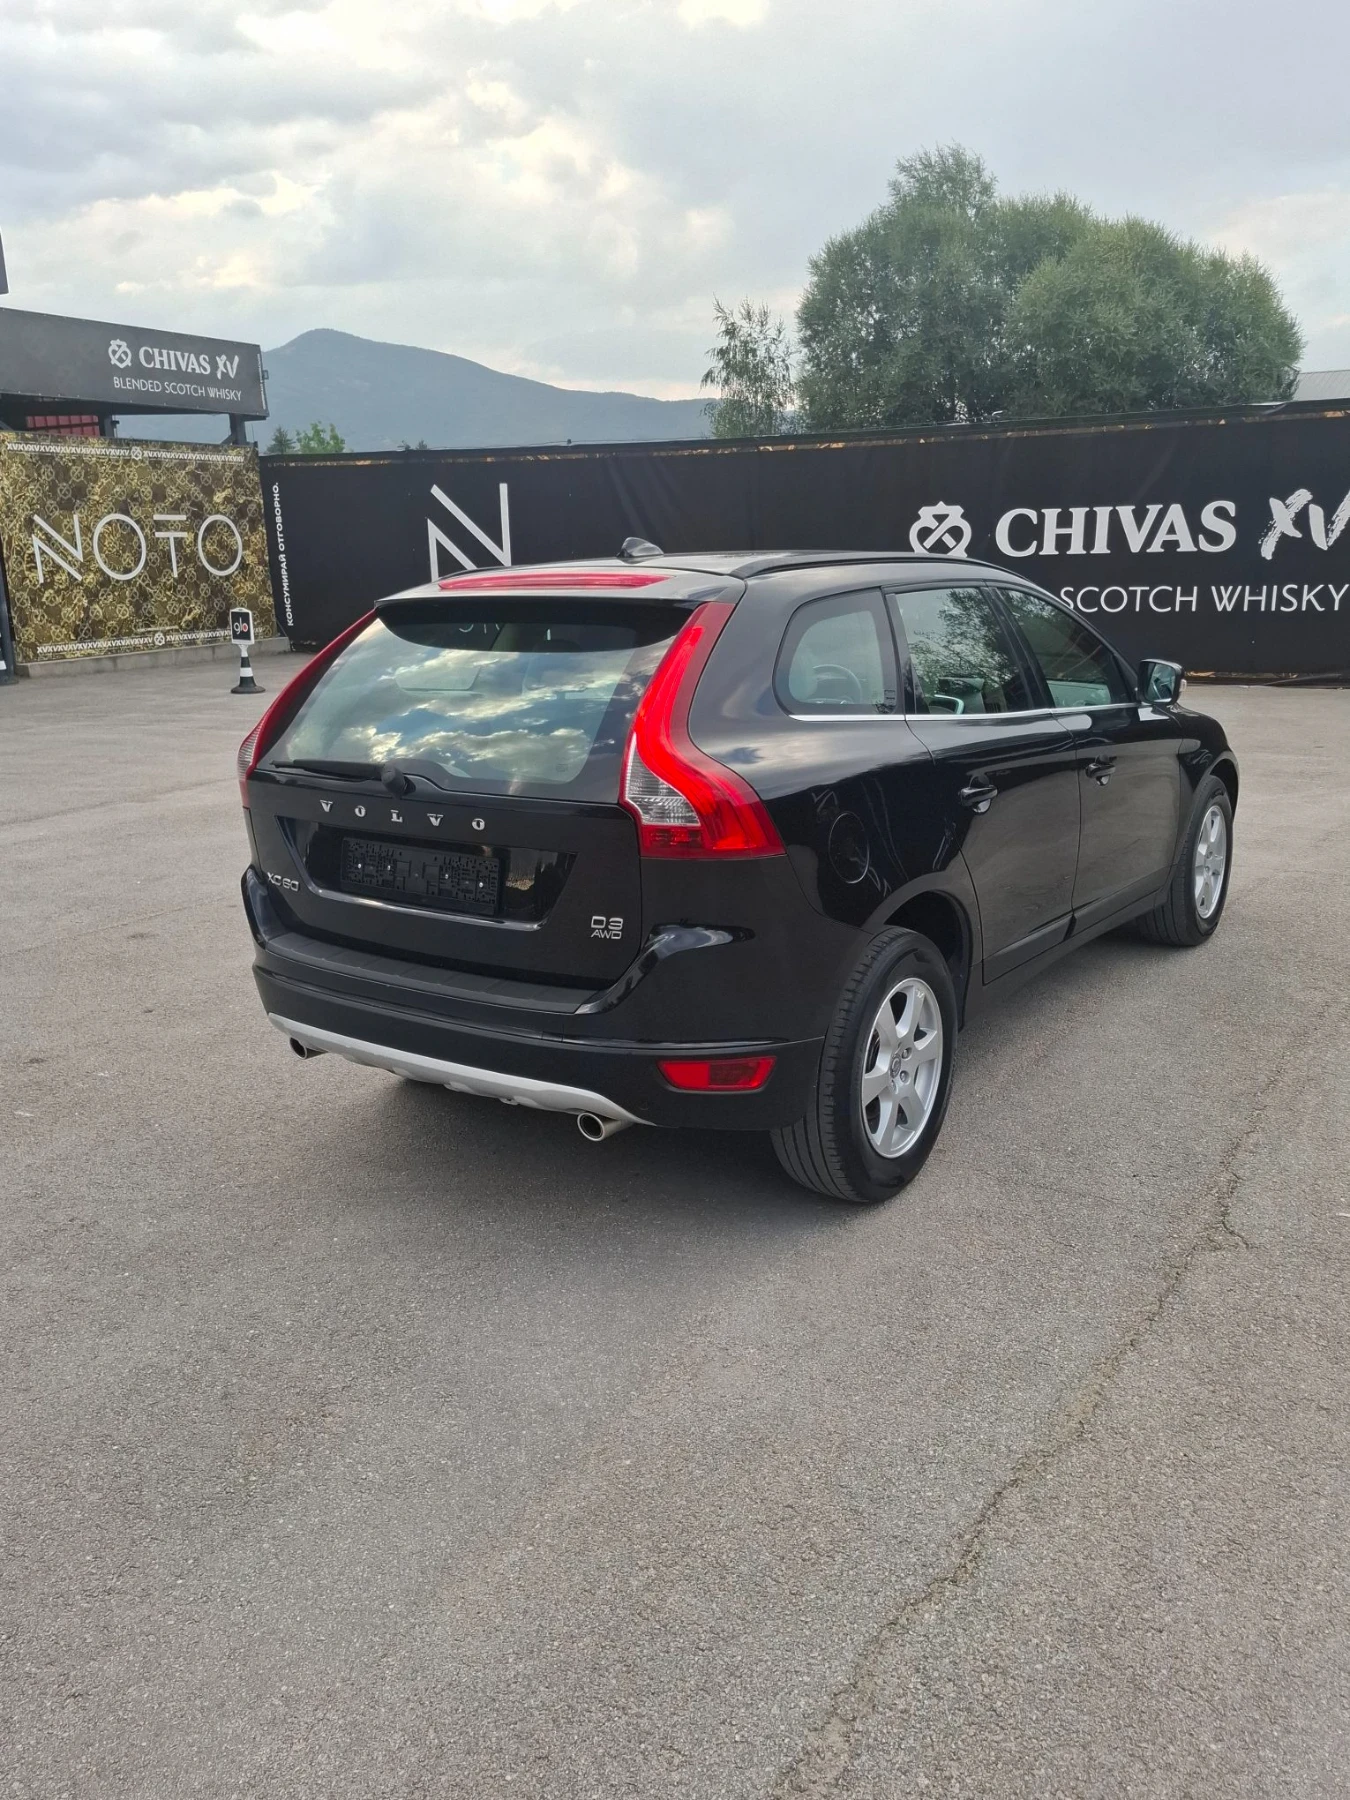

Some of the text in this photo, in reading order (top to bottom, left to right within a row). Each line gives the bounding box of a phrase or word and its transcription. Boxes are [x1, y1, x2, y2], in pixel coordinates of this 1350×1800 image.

[139, 346, 240, 380] CHIVAS XV
[113, 376, 242, 401] BLENDED SCOTCH WHISKY
[995, 500, 1237, 558] CHIVAS
[32, 513, 243, 584] NOTO
[272, 482, 294, 626] КОНСУМИРАЙ ОТГОВОРНО.
[1059, 583, 1350, 613] SCOTCH WHISKY
[233, 616, 249, 635] glo
[319, 800, 486, 831] VOLVO
[266, 871, 299, 892] XC60
[590, 915, 624, 930] D3
[590, 929, 622, 940] AWD
